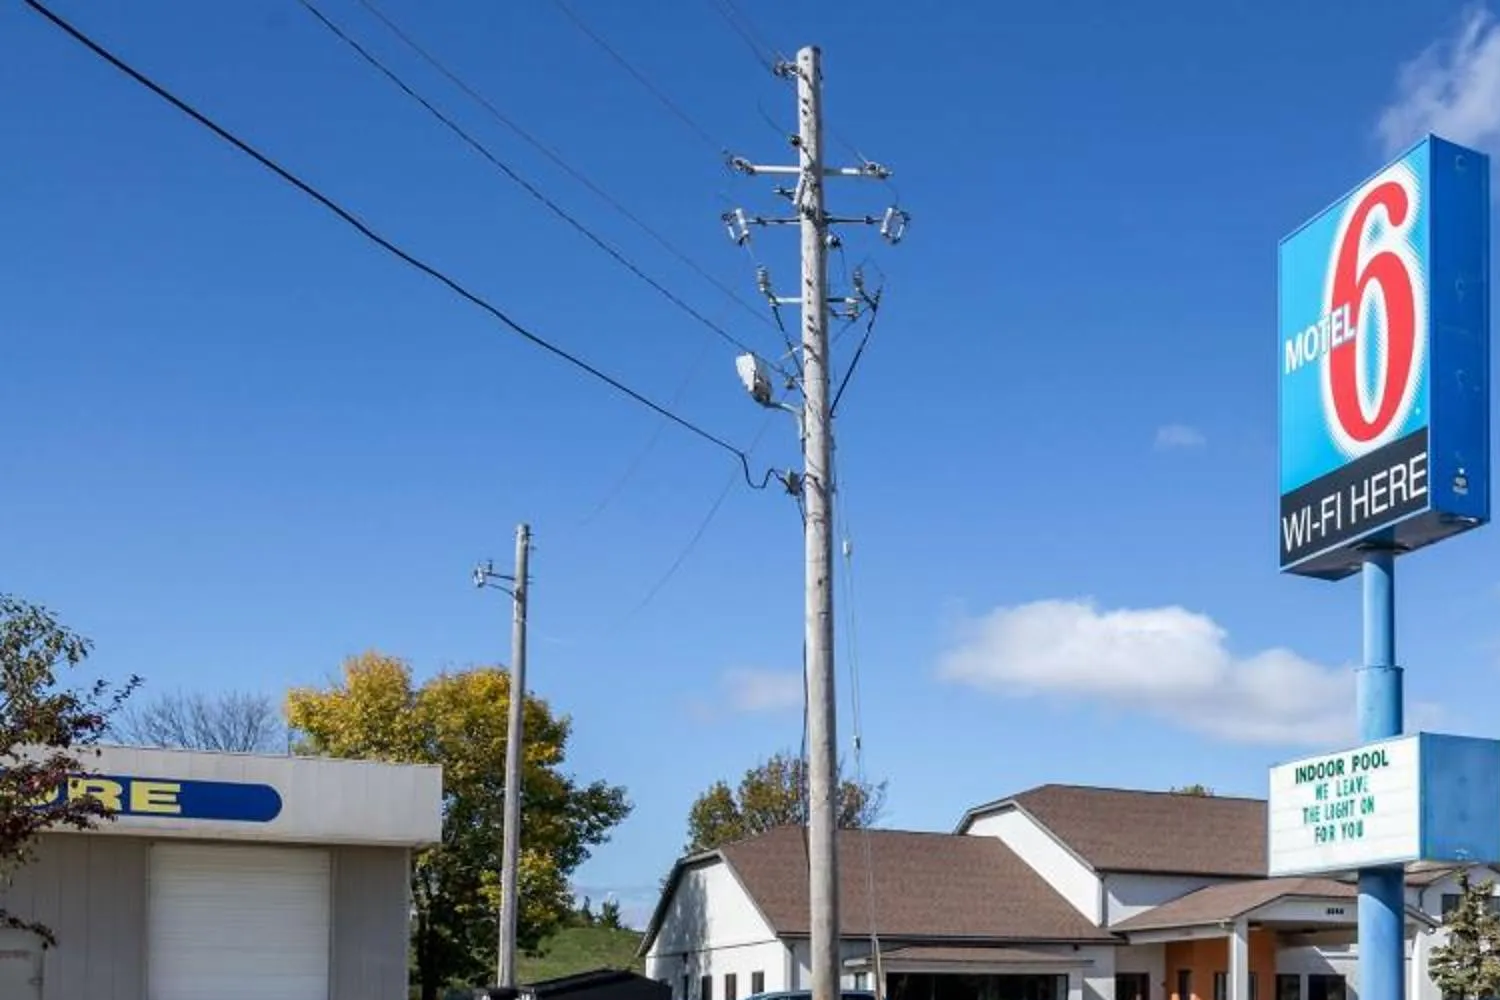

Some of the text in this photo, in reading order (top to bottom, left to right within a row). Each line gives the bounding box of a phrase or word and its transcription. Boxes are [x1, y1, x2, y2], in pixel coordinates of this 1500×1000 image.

[1285, 180, 1416, 443] MOTEL 6
[1282, 451, 1428, 553] WI-FI HERE
[1295, 749, 1389, 784] INDOOR POOL
[1315, 775, 1368, 801] WE LEAVE
[1302, 795, 1375, 824] THE LIGHT ON
[1315, 820, 1363, 843] FOR YOU
